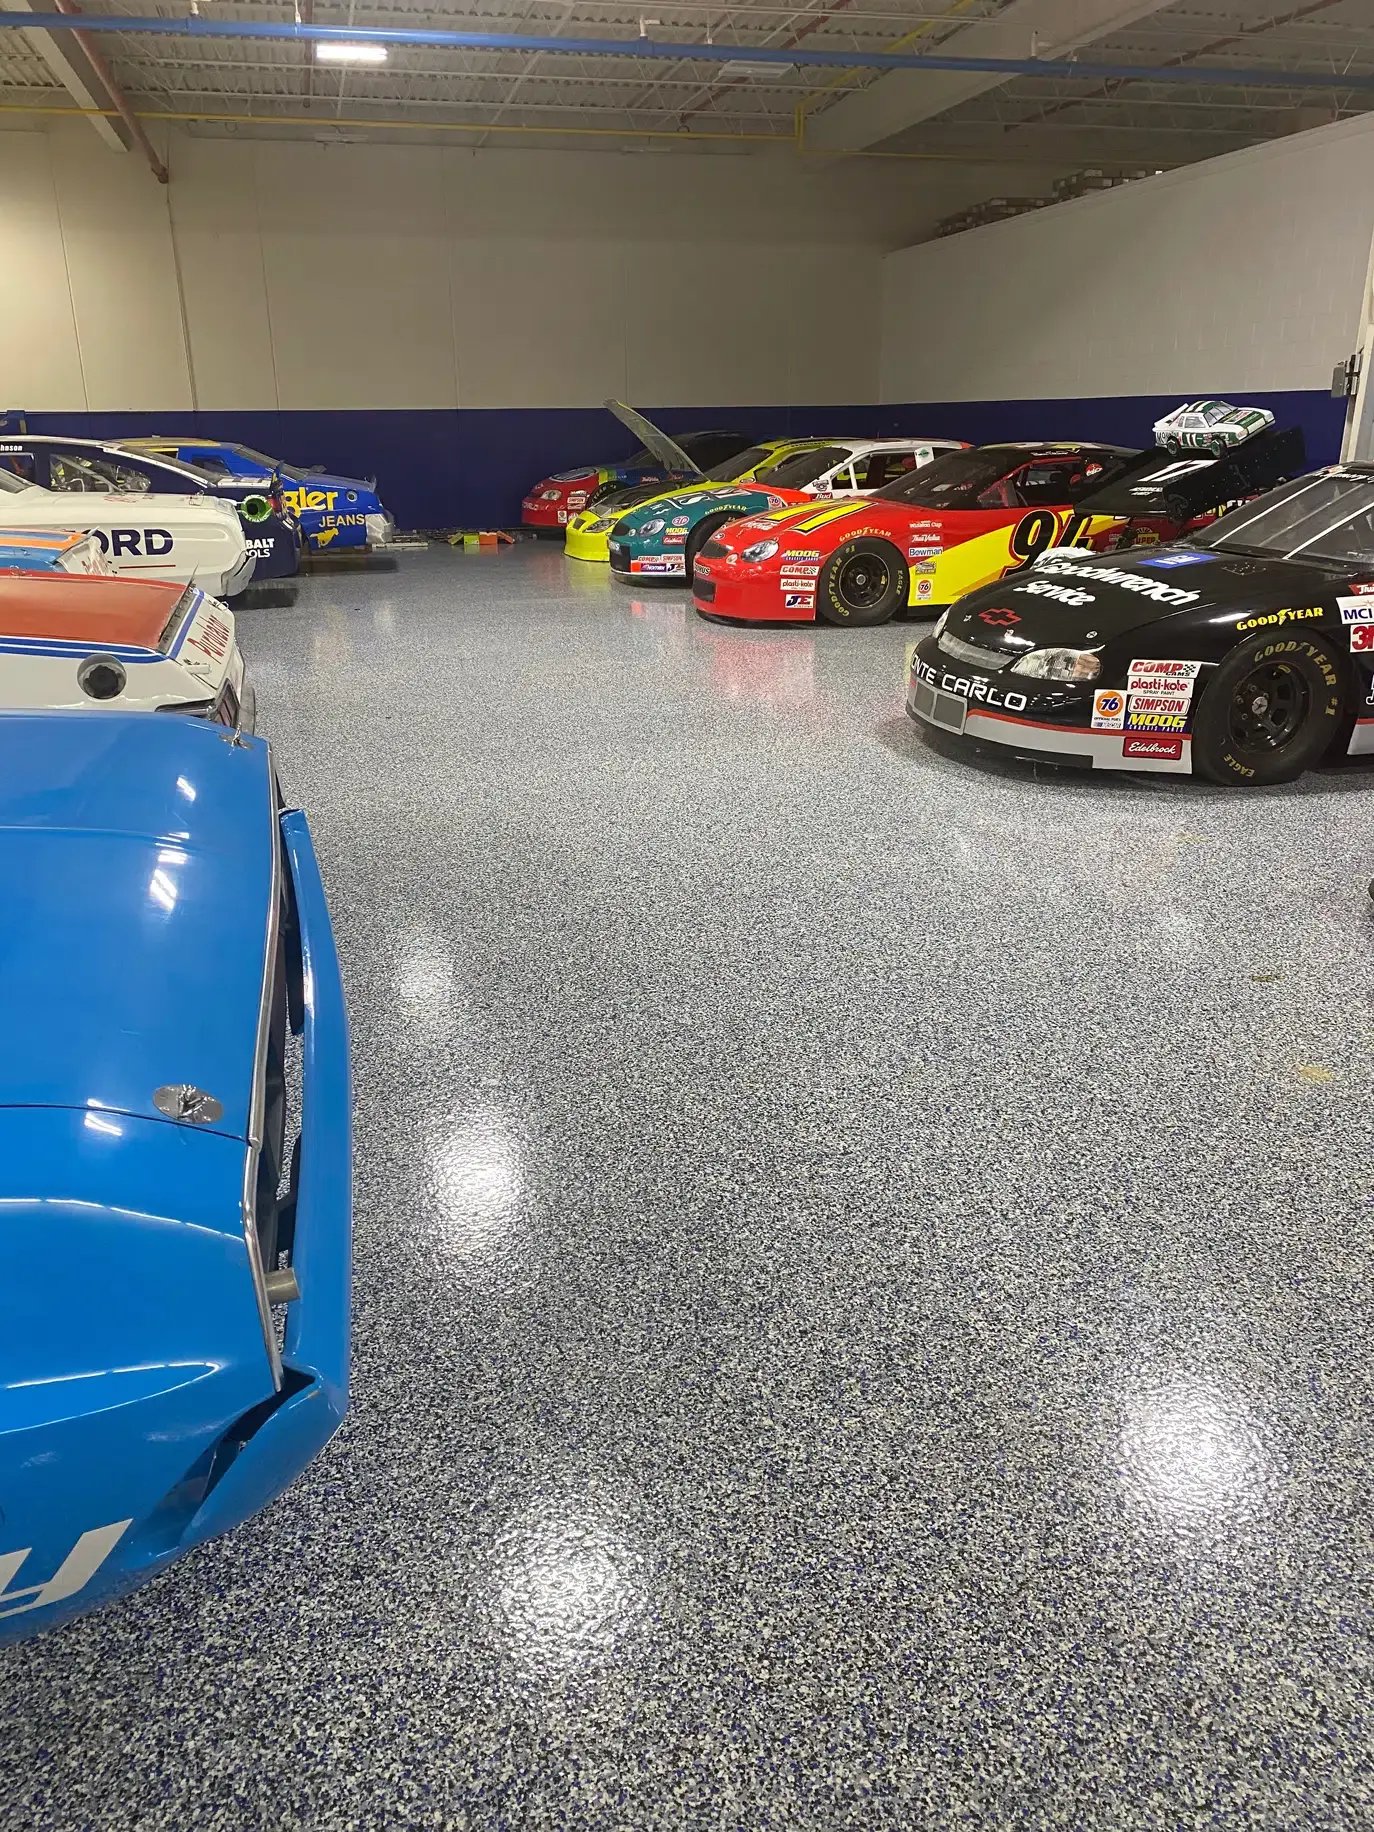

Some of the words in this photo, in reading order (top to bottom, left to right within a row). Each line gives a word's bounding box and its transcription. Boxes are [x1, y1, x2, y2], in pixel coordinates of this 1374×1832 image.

[0, 444, 23, 452] hnson
[704, 504, 747, 515] GOODYEAR
[319, 514, 366, 528] JEANS
[839, 526, 892, 542] GOODYEAR
[245, 538, 275, 549] BALT
[246, 549, 271, 558] OLS
[909, 547, 943, 556] Bowman
[919, 583, 929, 591] 76
[1035, 559, 1201, 606] Goodwrench
[1358, 584, 1374, 594] Tru
[1013, 580, 1096, 606] Service
[787, 595, 811, 606] JE
[1236, 607, 1324, 631] GOODYEAR
[1343, 608, 1373, 620] MCI
[187, 614, 230, 665] Purolator
[1131, 661, 1184, 673] COMP
[1254, 640, 1337, 686] GOODYEAR
[911, 655, 937, 685] ONTE
[941, 674, 1028, 711] CARLO
[1130, 678, 1189, 691] plasti-kote
[1101, 697, 1119, 711] 76
[1132, 697, 1184, 713] SIMPSON
[1127, 713, 1188, 728] MOOG
[1128, 741, 1177, 754] Edelbrock
[1223, 753, 1255, 777] EAGLE
